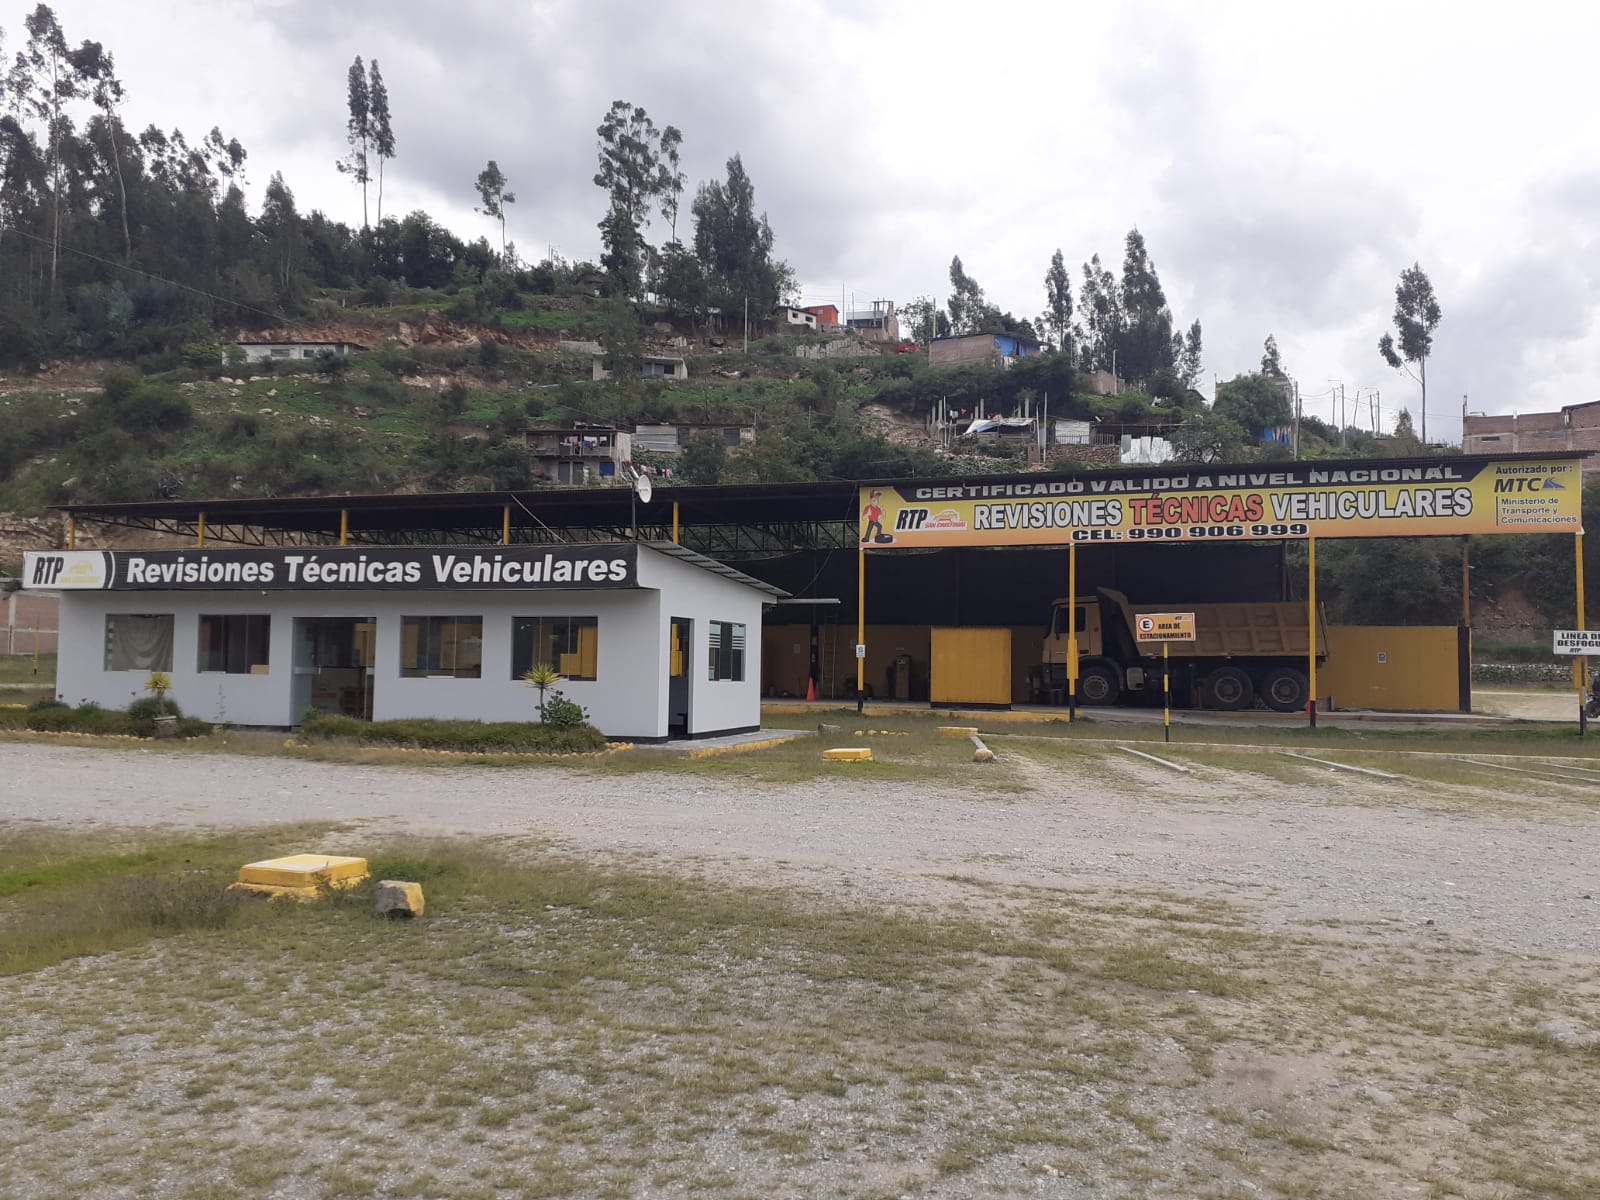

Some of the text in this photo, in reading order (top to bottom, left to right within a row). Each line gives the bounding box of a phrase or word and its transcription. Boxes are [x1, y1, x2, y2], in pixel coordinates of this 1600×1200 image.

[1496, 465, 1547, 474] Autorizado
[916, 466, 1462, 499] CERTIFICADO VALIDO A NIVEL NACIONAL
[1494, 478, 1541, 492] MTC
[974, 488, 1473, 529] REVISIONES TÉCNICAS VEHICULARES
[896, 509, 928, 529] RTP
[1071, 523, 1309, 541] CEL: 990 906 999
[33, 557, 64, 584] RTP
[127, 554, 628, 584] Revisiones Técnicas Vehiculares
[1143, 621, 1150, 629] E
